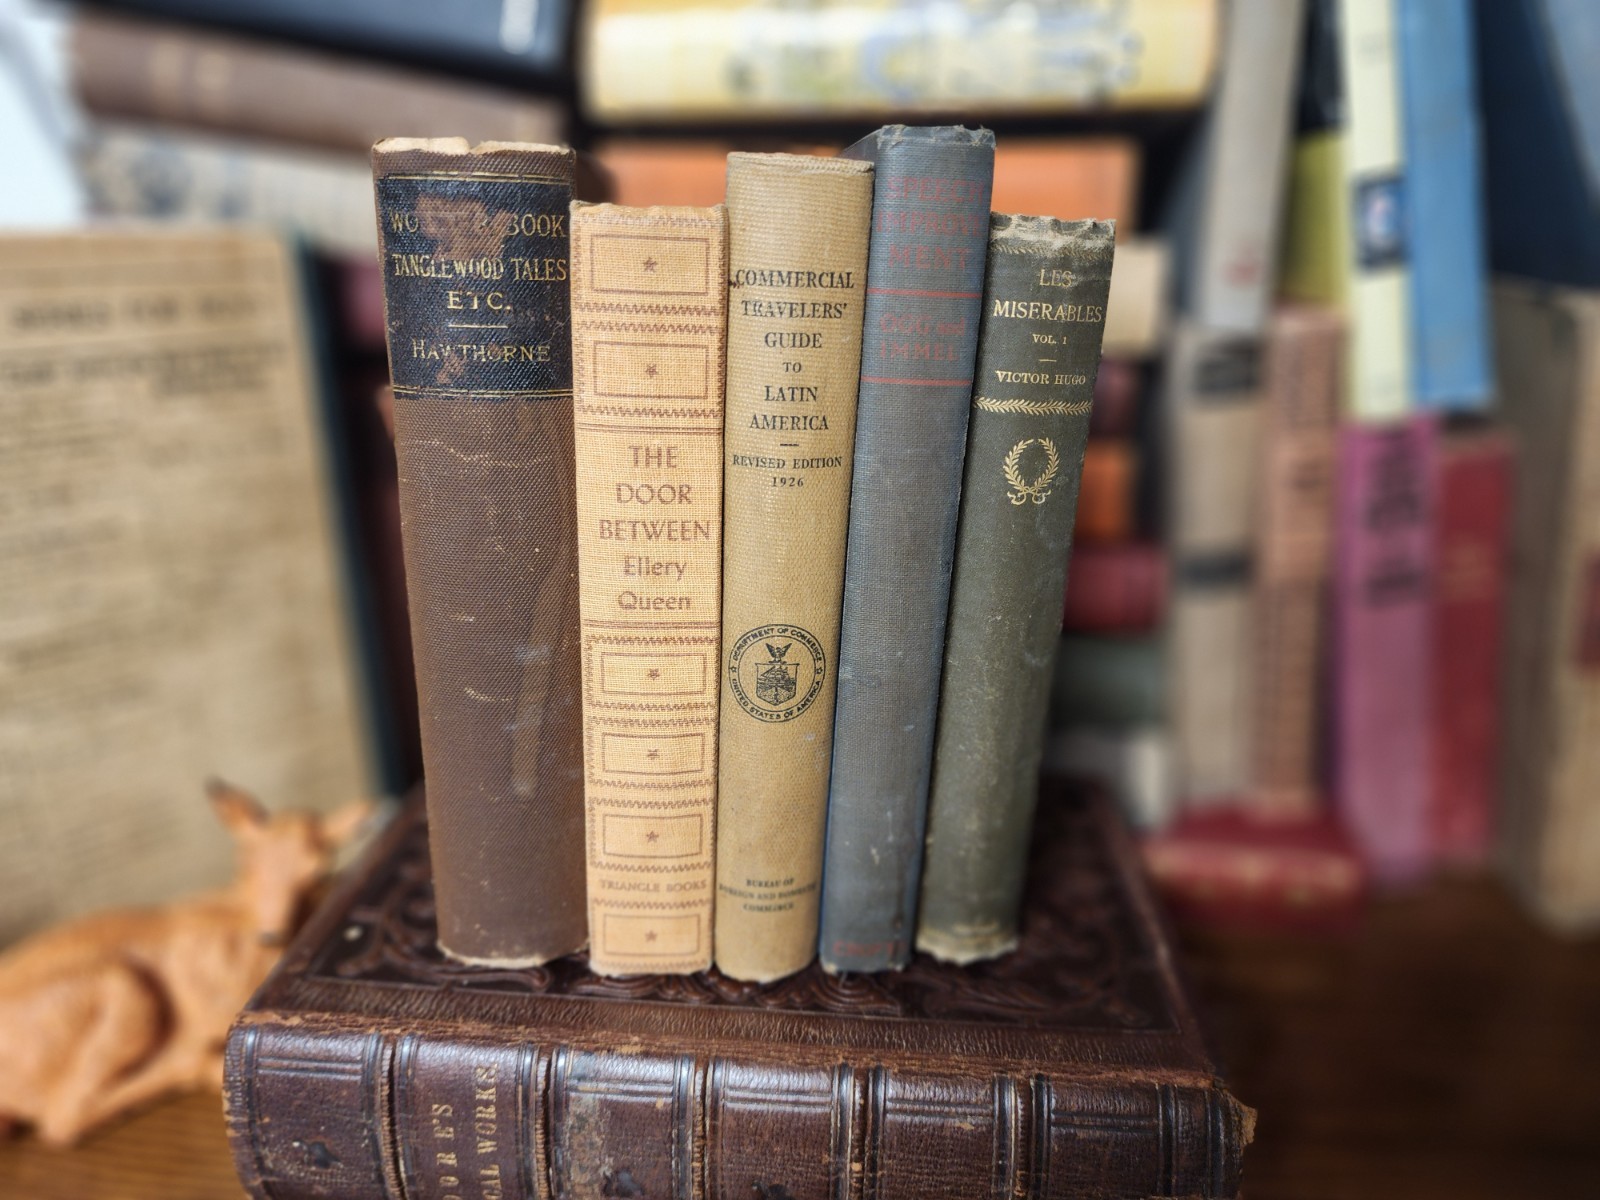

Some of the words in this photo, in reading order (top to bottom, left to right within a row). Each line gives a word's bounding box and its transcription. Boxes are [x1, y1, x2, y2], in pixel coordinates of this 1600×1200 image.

[507, 214, 566, 238] BOOK
[392, 254, 504, 280] TANGLEWOOD
[510, 257, 567, 281] TALES
[888, 244, 972, 271] MENT
[735, 269, 855, 289] COMMERCIAL
[1039, 268, 1073, 289] LES
[447, 290, 511, 310] ETC.
[741, 299, 847, 319] TRAVELERS'
[993, 299, 1103, 323] MISERABLES
[764, 332, 822, 349] GUIDE
[1032, 333, 1057, 345] VOL.
[411, 338, 551, 362] HAWTHORNE
[783, 361, 802, 373] TO
[995, 370, 1050, 386] VICTOR
[1054, 374, 1086, 386] HUGO
[764, 385, 818, 402] LATIN
[750, 414, 829, 431] AMERICA
[628, 445, 678, 469] THE
[732, 454, 786, 469] REVISED
[793, 455, 843, 469] EDITION
[771, 476, 804, 488] 1926
[615, 483, 692, 505] DOOR
[599, 519, 711, 542] BETWEEN
[624, 555, 687, 582] Ellery
[617, 590, 691, 611] Queen
[777, 627, 789, 635] OF
[790, 629, 823, 662] COMMERCE
[732, 678, 750, 708] UNITED
[749, 707, 782, 720] STATES
[783, 710, 795, 719] OF
[796, 680, 821, 713] AMERICA
[599, 880, 661, 893] TRIANGLE
[665, 879, 707, 893] BOOKS
